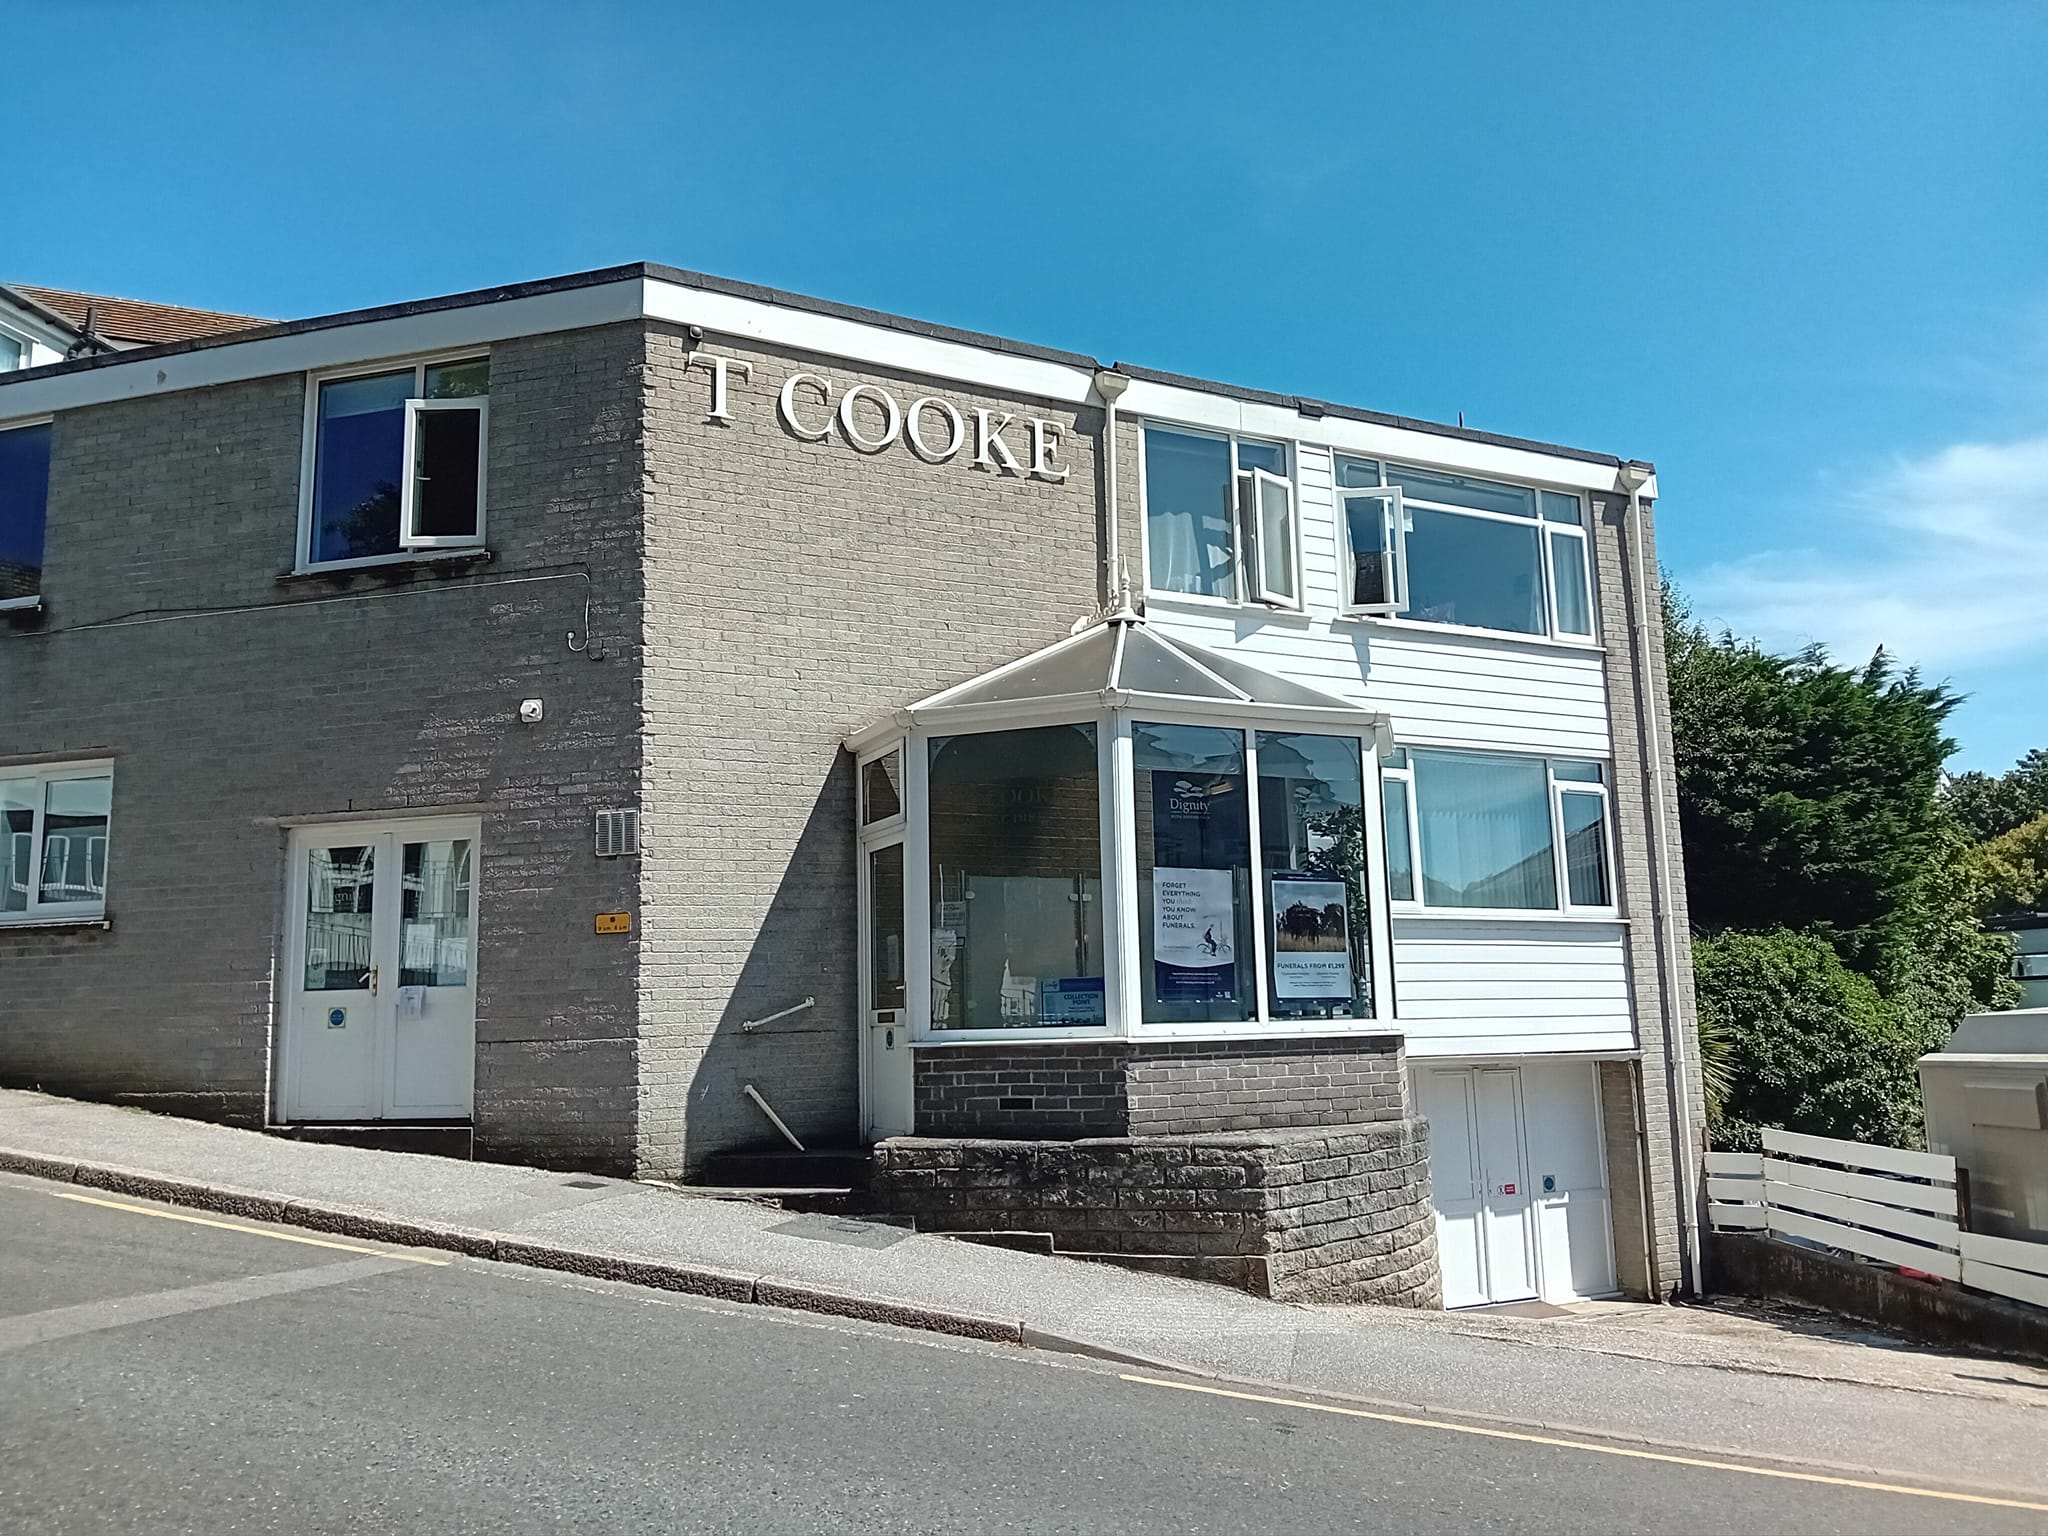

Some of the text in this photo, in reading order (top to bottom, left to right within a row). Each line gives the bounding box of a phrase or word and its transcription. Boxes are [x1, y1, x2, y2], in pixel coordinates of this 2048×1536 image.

[689, 350, 1070, 478] T COOKE
[1169, 798, 1211, 815] Dignity
[1162, 881, 1186, 889] FORGET
[1162, 890, 1201, 898] EVERYTHING
